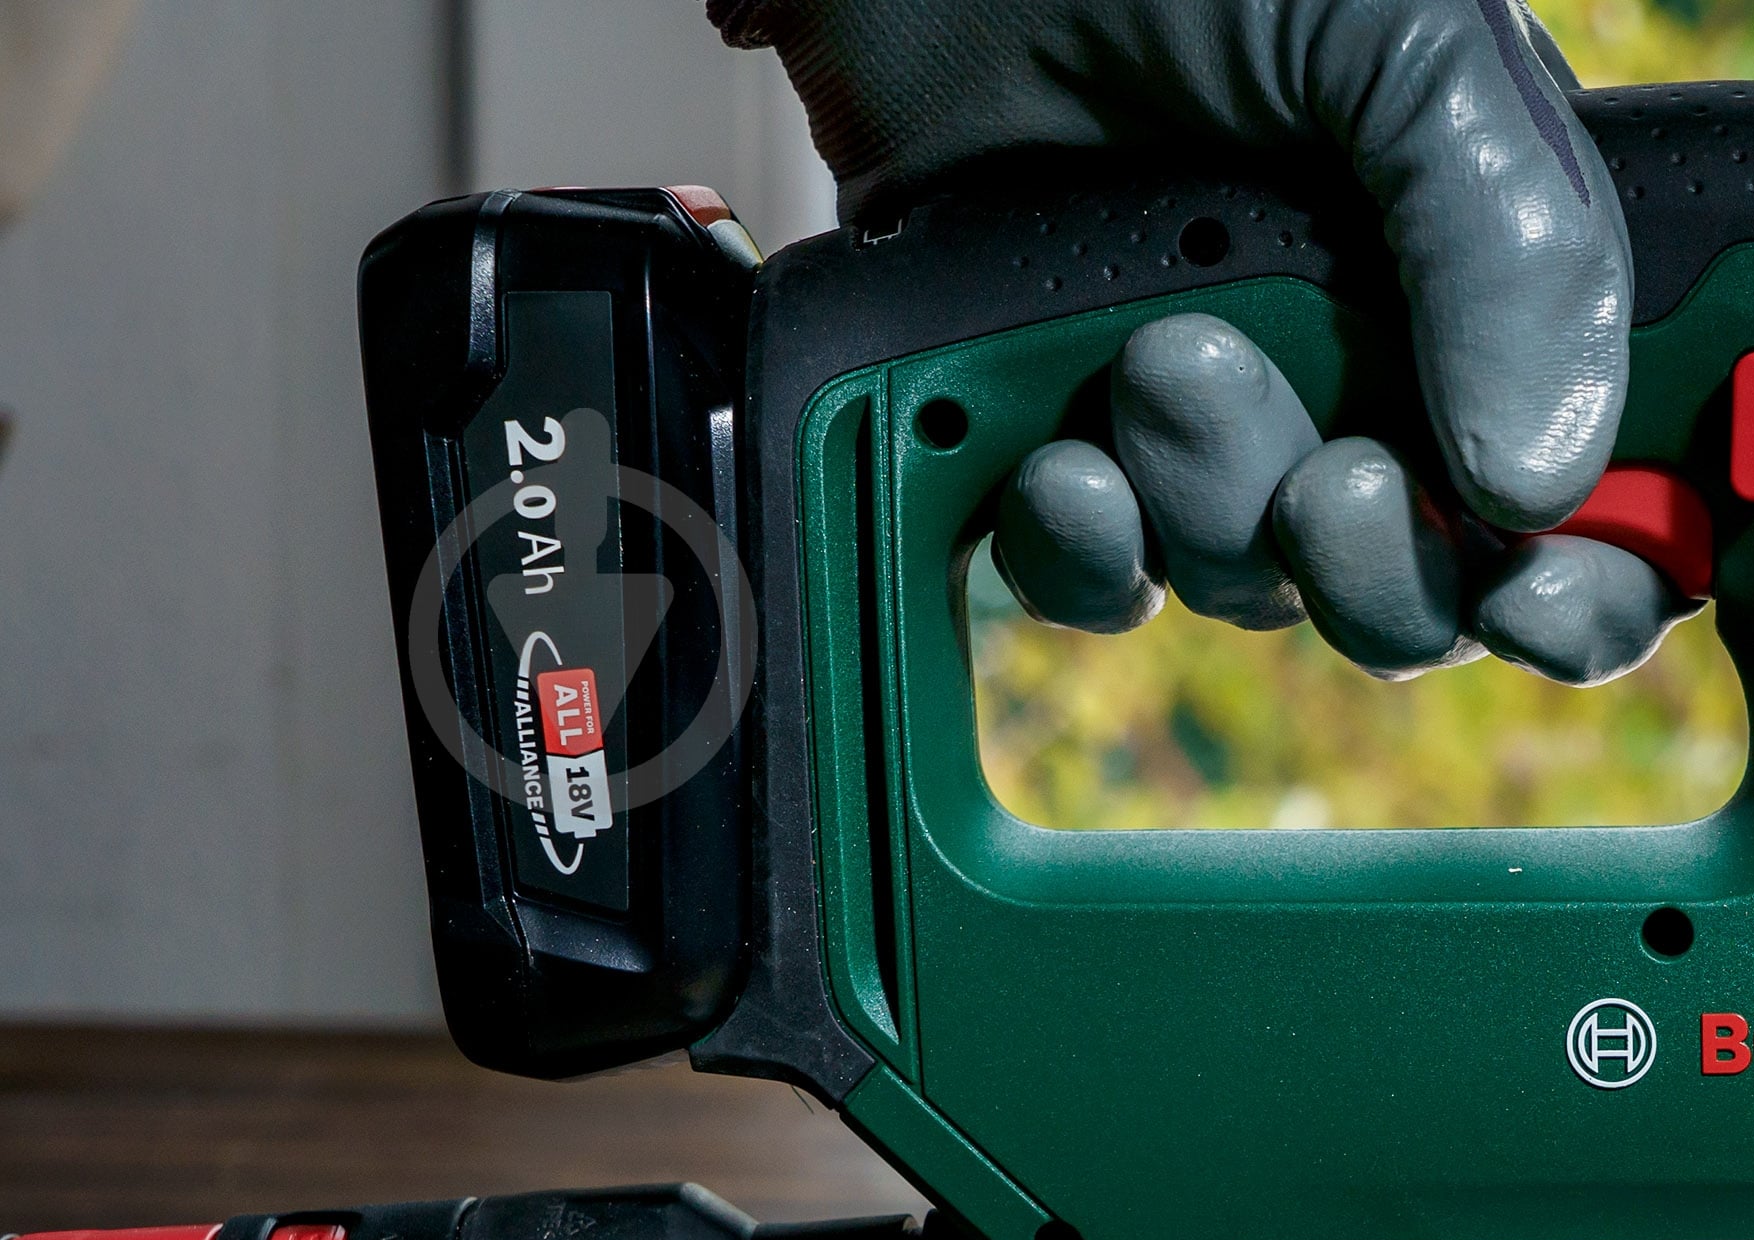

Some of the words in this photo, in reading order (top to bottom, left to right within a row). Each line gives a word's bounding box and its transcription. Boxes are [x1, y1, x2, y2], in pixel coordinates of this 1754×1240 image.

[504, 416, 566, 519] 2.0
[517, 531, 565, 595] Ah
[553, 684, 583, 746] ALL
[580, 680, 592, 714] POWER
[585, 715, 595, 735] FOR
[514, 701, 544, 811] ALLIANCE
[565, 766, 596, 822] 18V
